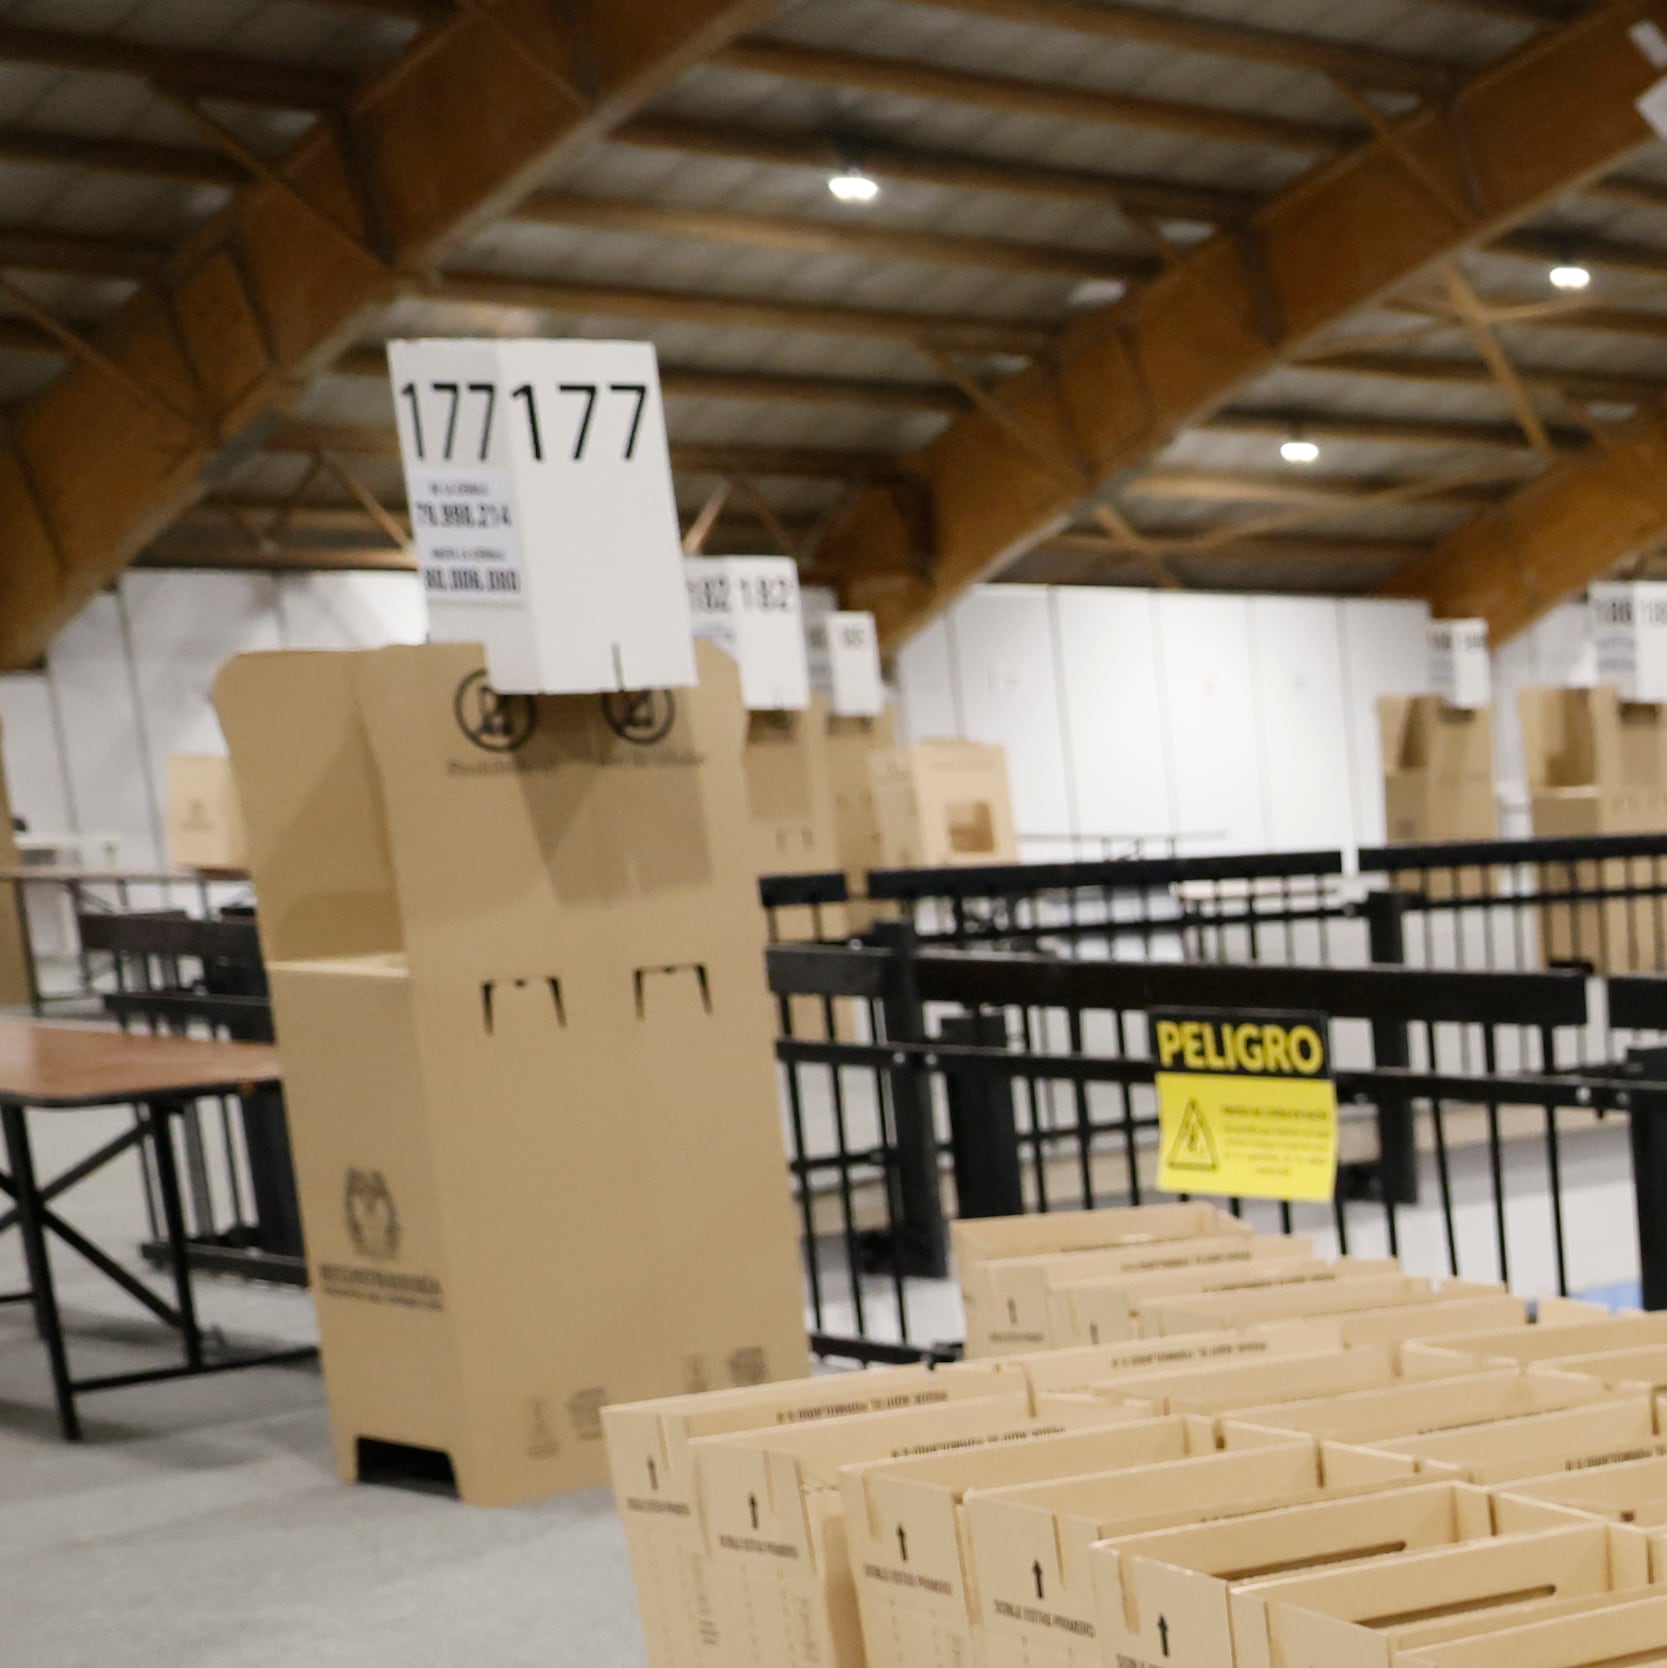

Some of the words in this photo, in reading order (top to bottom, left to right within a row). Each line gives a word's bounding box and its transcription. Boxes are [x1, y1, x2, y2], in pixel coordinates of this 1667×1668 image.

[401, 382, 497, 461] 177
[511, 383, 648, 461] 177
[1156, 1020, 1323, 1074] PELIGRO
